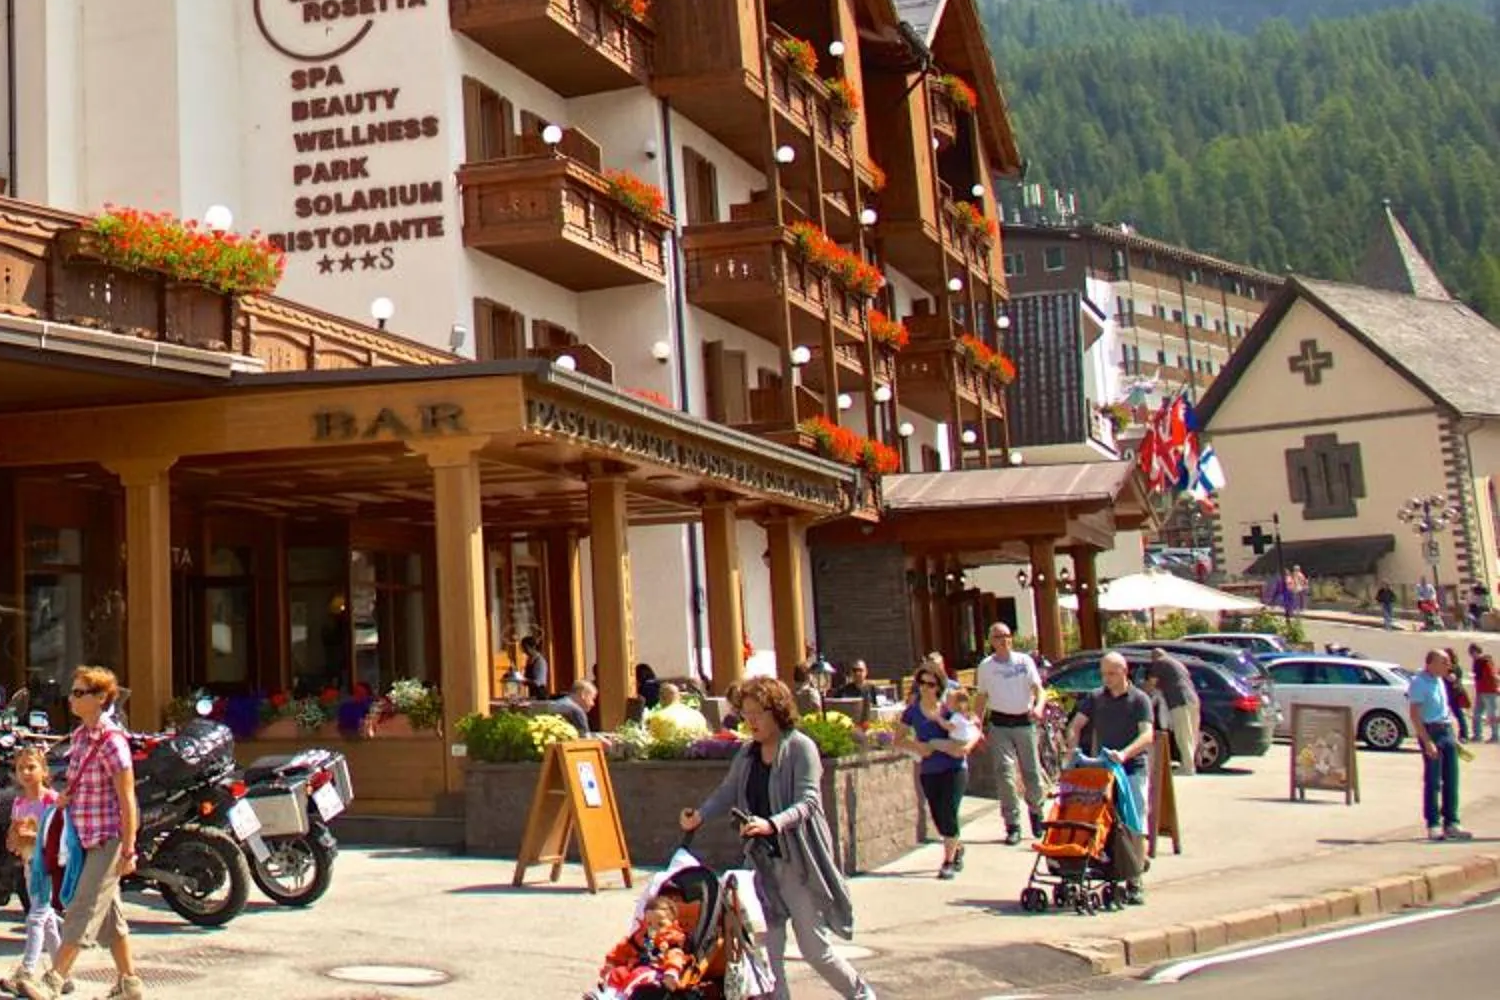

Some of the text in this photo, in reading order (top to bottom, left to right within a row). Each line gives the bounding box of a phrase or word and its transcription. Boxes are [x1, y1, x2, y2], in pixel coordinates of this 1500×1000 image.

[290, 65, 344, 91] SPA
[291, 87, 400, 122] BEAUTY
[294, 116, 439, 152] WELLNESS
[293, 157, 370, 185] PARK
[294, 181, 443, 218] SOLARIUM
[267, 215, 445, 253] RISTORANTE
[311, 403, 470, 441] BAR
